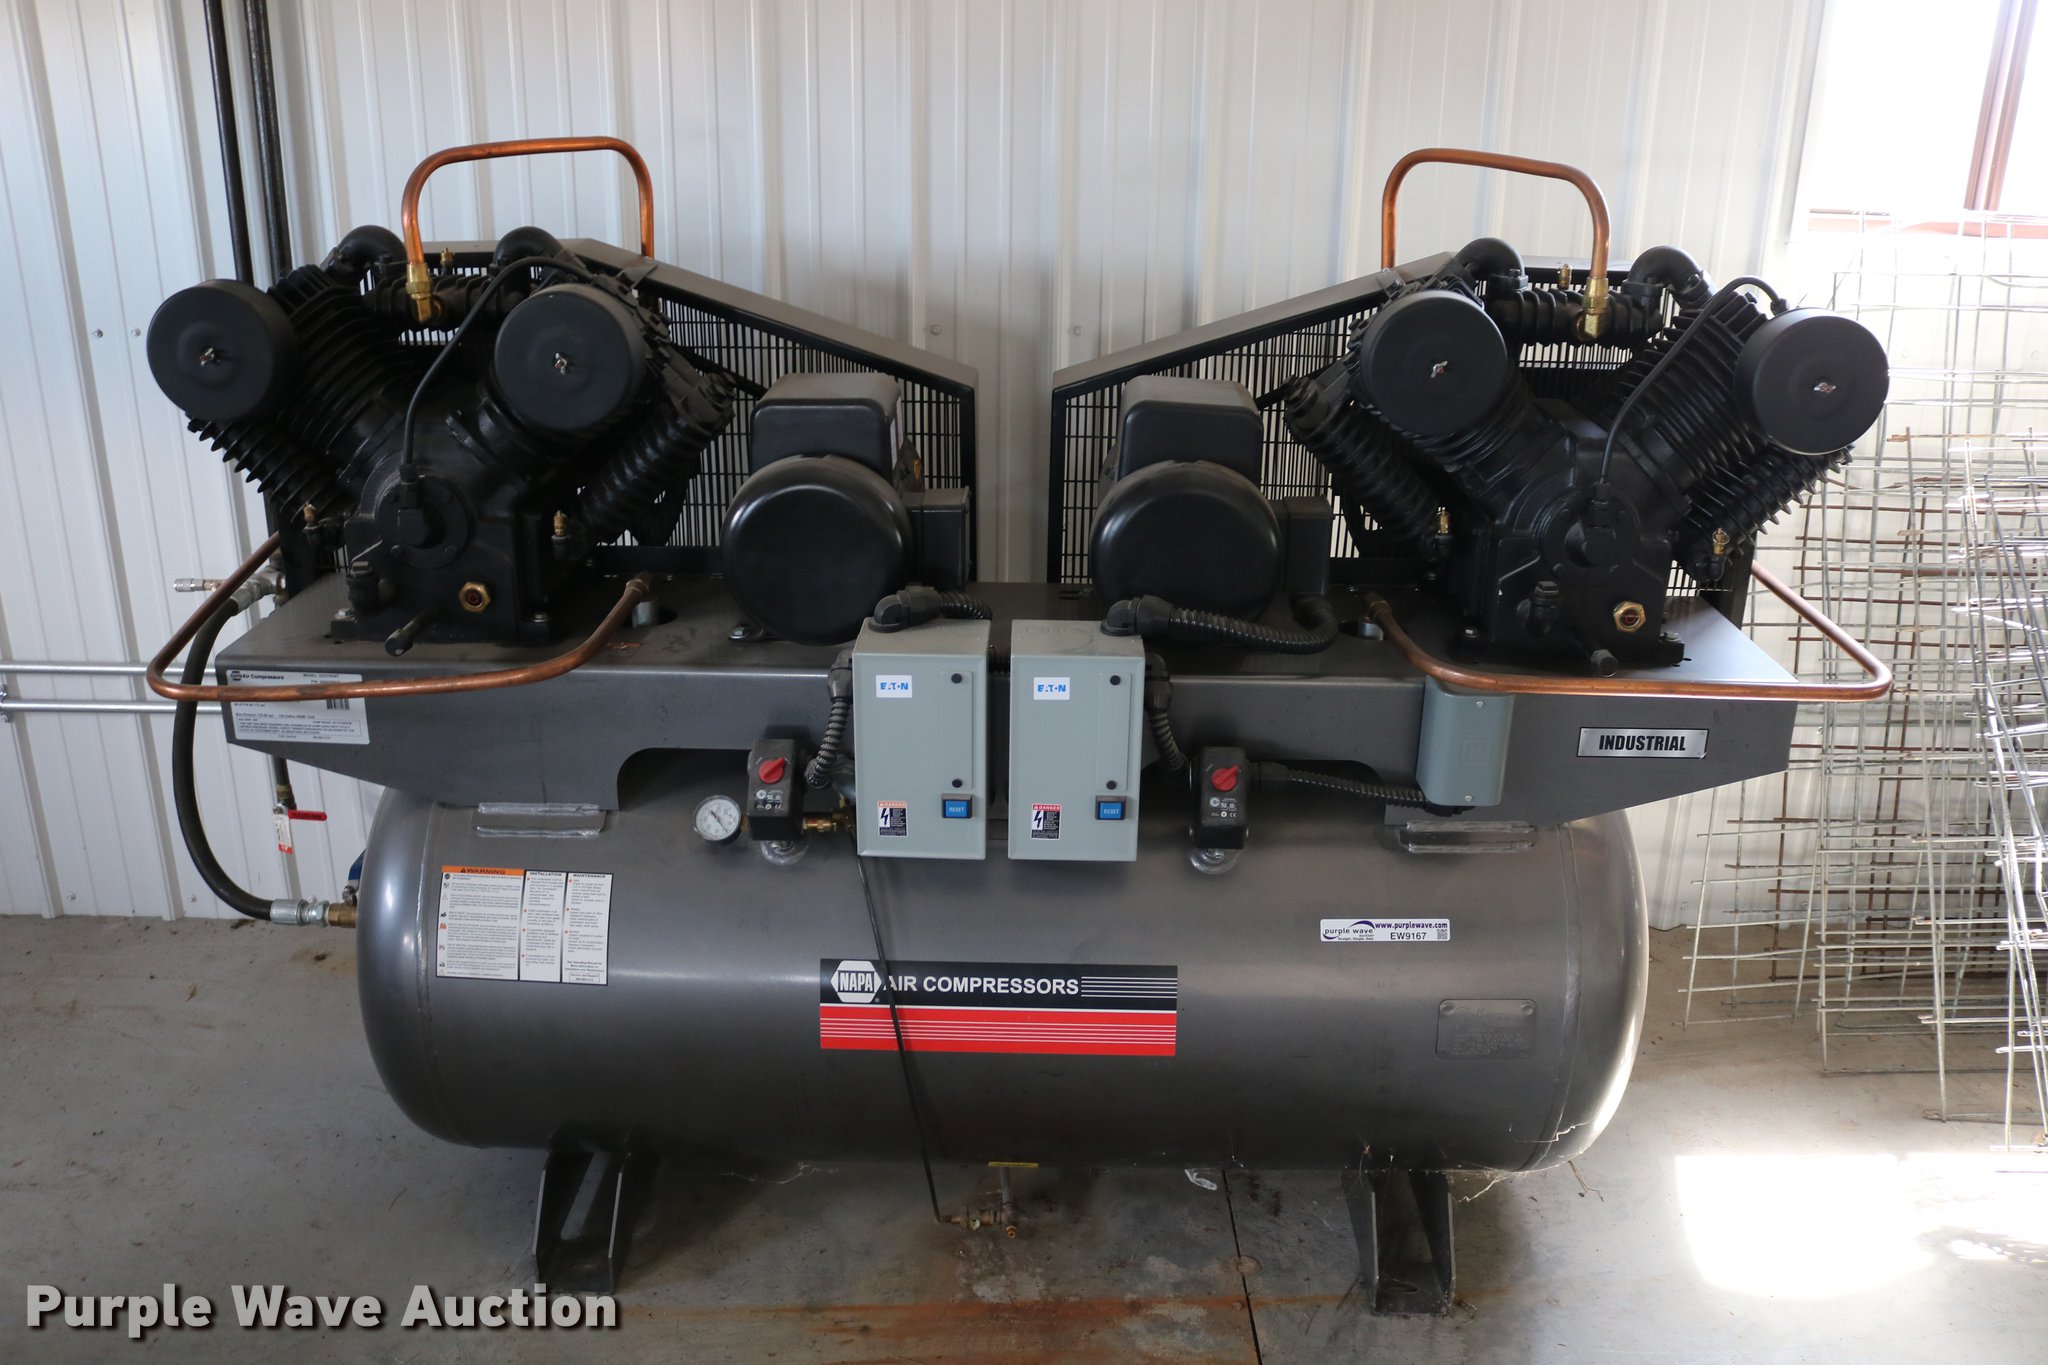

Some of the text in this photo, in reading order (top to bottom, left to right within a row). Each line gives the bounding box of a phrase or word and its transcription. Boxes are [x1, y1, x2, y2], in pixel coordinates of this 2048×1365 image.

[250, 673, 285, 681] Compressors
[1599, 735, 1686, 751] INDUSTRIAL
[1375, 922, 1448, 930] www.purplewave.com
[1390, 932, 1427, 940] EW9167
[839, 972, 874, 992] NAPA
[883, 976, 1079, 994] AIR COMPRESSORS
